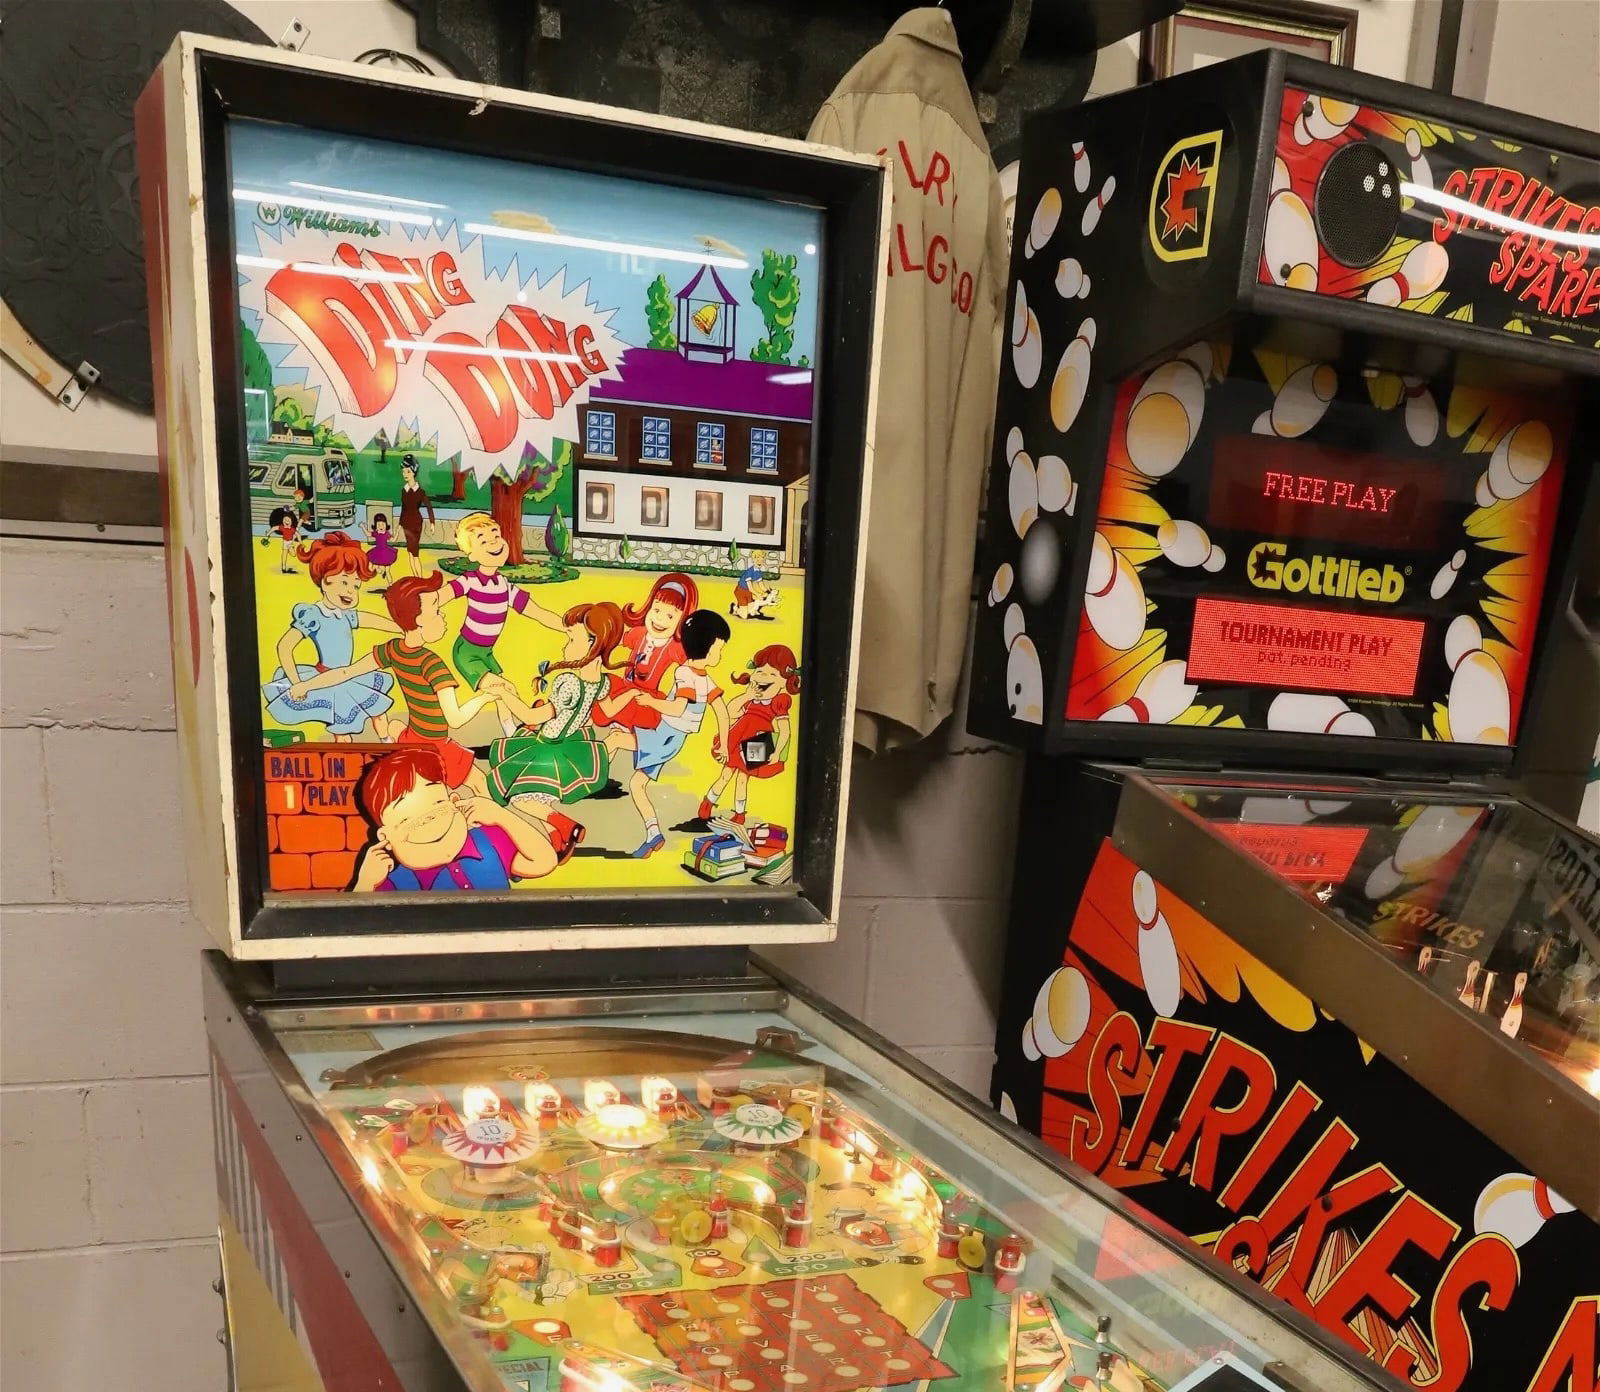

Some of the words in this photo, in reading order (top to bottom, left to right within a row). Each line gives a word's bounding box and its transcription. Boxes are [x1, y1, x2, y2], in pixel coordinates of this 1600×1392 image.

[283, 204, 380, 238] Williams
[423, 304, 609, 453] DONG
[1263, 472, 1327, 503] FREE
[1330, 481, 1396, 512] PLAY
[1247, 542, 1405, 603] Gottlieb
[1220, 620, 1345, 652] TOURNAMENT
[1350, 633, 1394, 656] PLAY
[1290, 653, 1351, 672] pending
[271, 756, 314, 778] BALL
[327, 757, 346, 777] IN
[283, 784, 295, 809] 1
[308, 785, 350, 806] PLAY
[480, 1124, 501, 1136] 10
[774, 1263, 828, 1275] 500
[787, 1253, 827, 1263] 200
[591, 1273, 632, 1282] 200
[597, 1280, 652, 1291] 500
